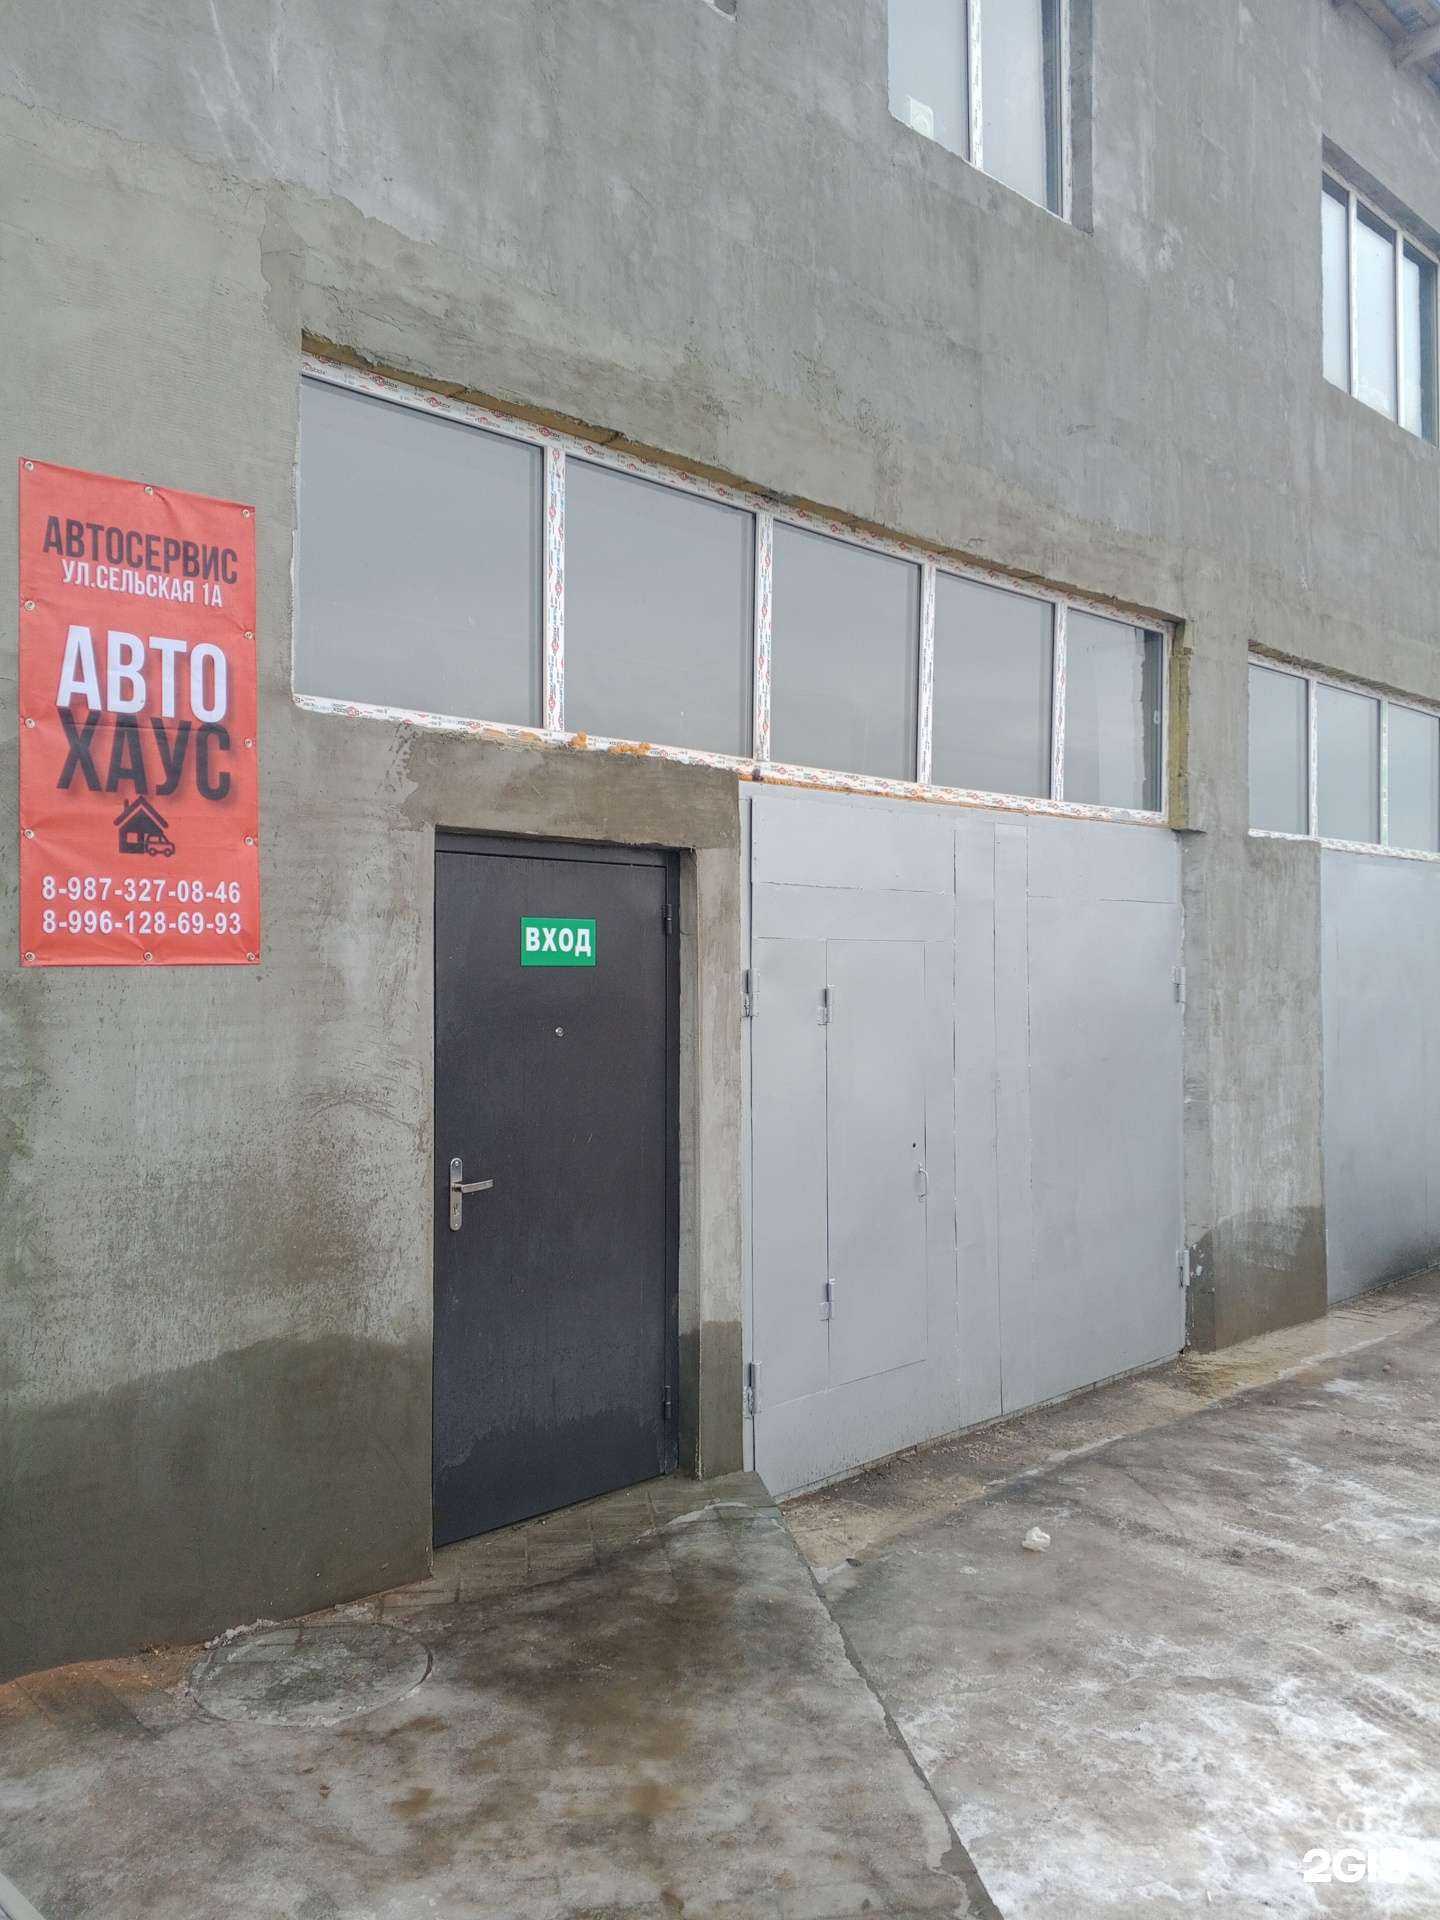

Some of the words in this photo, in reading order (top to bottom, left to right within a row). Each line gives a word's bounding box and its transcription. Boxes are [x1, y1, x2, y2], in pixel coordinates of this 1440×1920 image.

[42, 515, 239, 585] АВТОСЕРВИС
[61, 558, 195, 604] УЛ.СЕЛЬСКАЯ
[201, 584, 224, 608] 1А
[55, 623, 229, 724] АВТО
[55, 705, 232, 801] ХАУС
[41, 875, 242, 904] 8-987-327-08-46
[41, 908, 242, 936] 8-996-128-69-93
[525, 926, 592, 957] ВХОД
